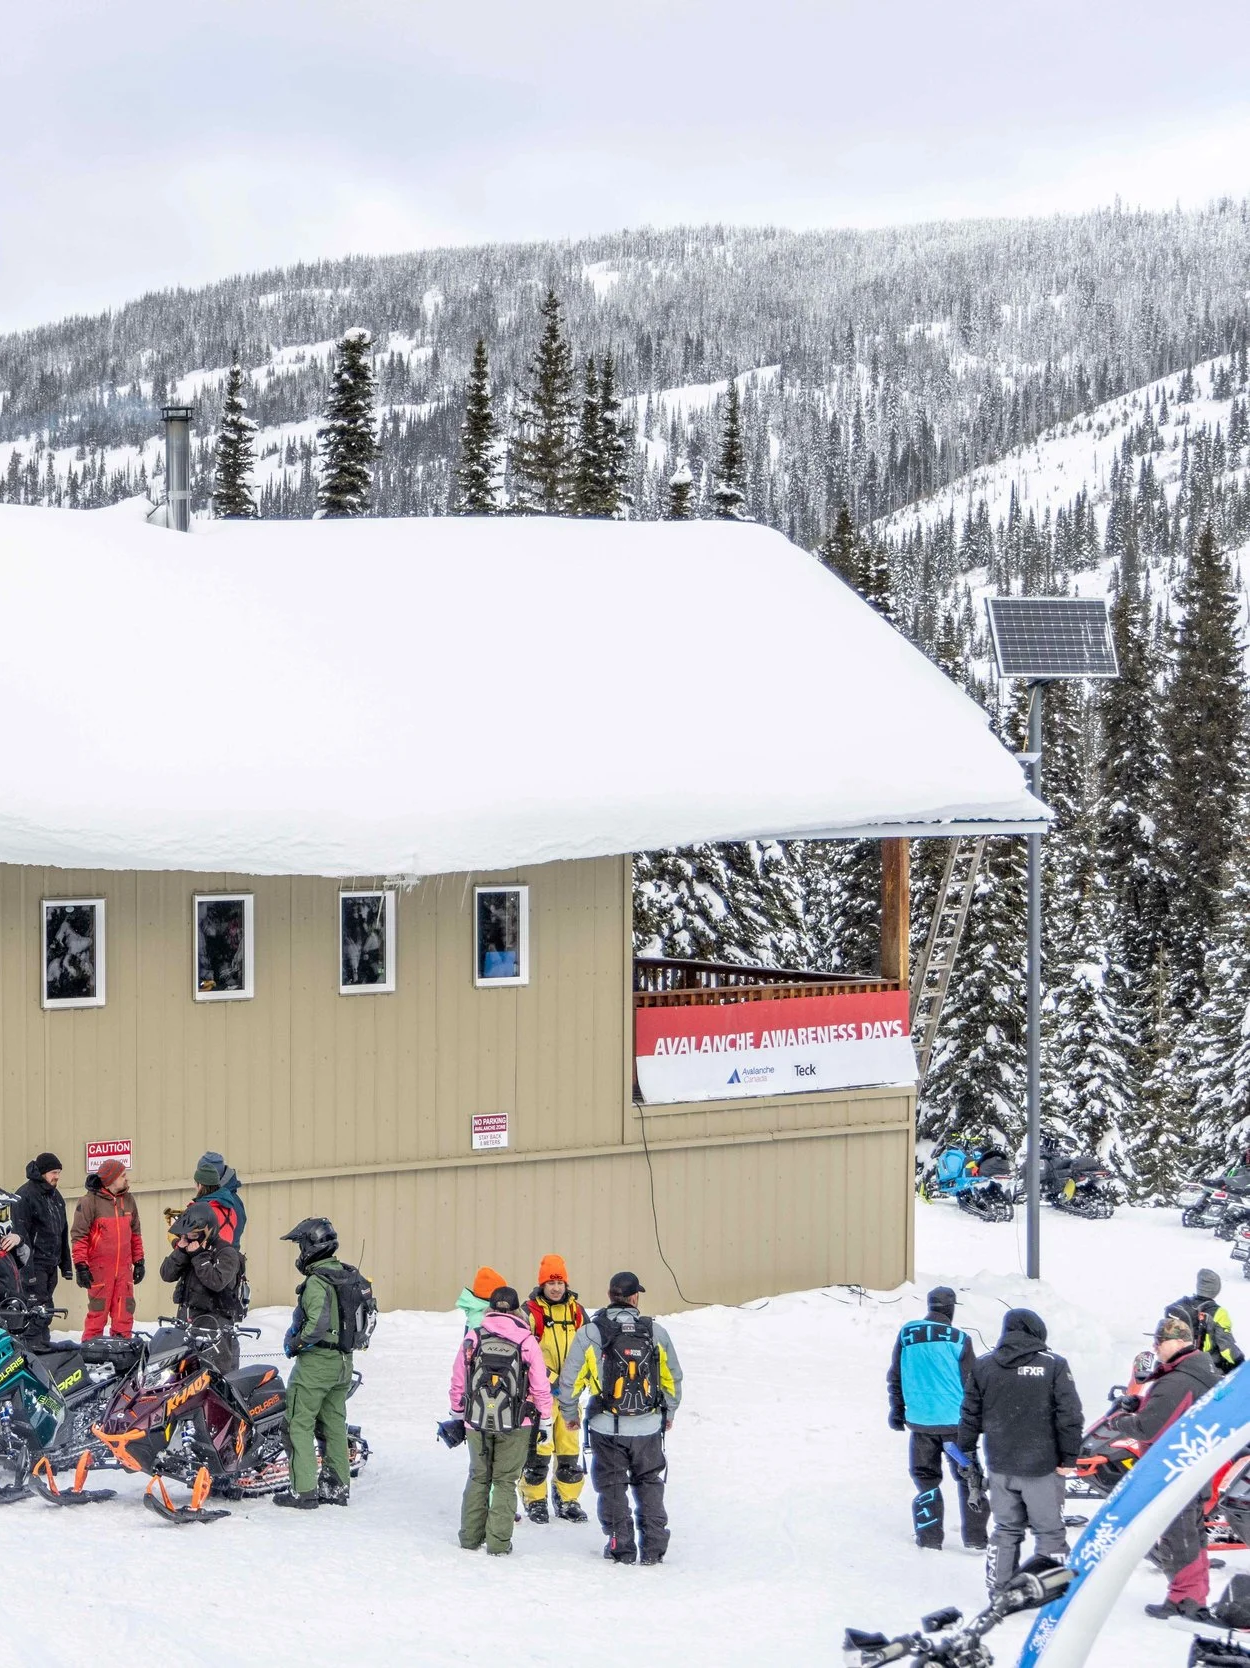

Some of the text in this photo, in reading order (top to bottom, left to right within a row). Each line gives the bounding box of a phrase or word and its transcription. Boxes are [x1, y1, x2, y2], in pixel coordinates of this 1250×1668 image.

[653, 1019, 903, 1056] AVALANCHE AWARENESS DAYS
[742, 1065, 775, 1076] Avalanche
[794, 1063, 816, 1077] Teck
[743, 1074, 768, 1084] Canada
[473, 1117, 506, 1126] NO PARKING
[89, 1142, 130, 1154] CAUTION
[1023, 1366, 1045, 1377] FXR
[57, 1369, 82, 1392] PRO
[166, 1369, 211, 1416] KHAOS
[249, 1394, 281, 1417] POLARIS
